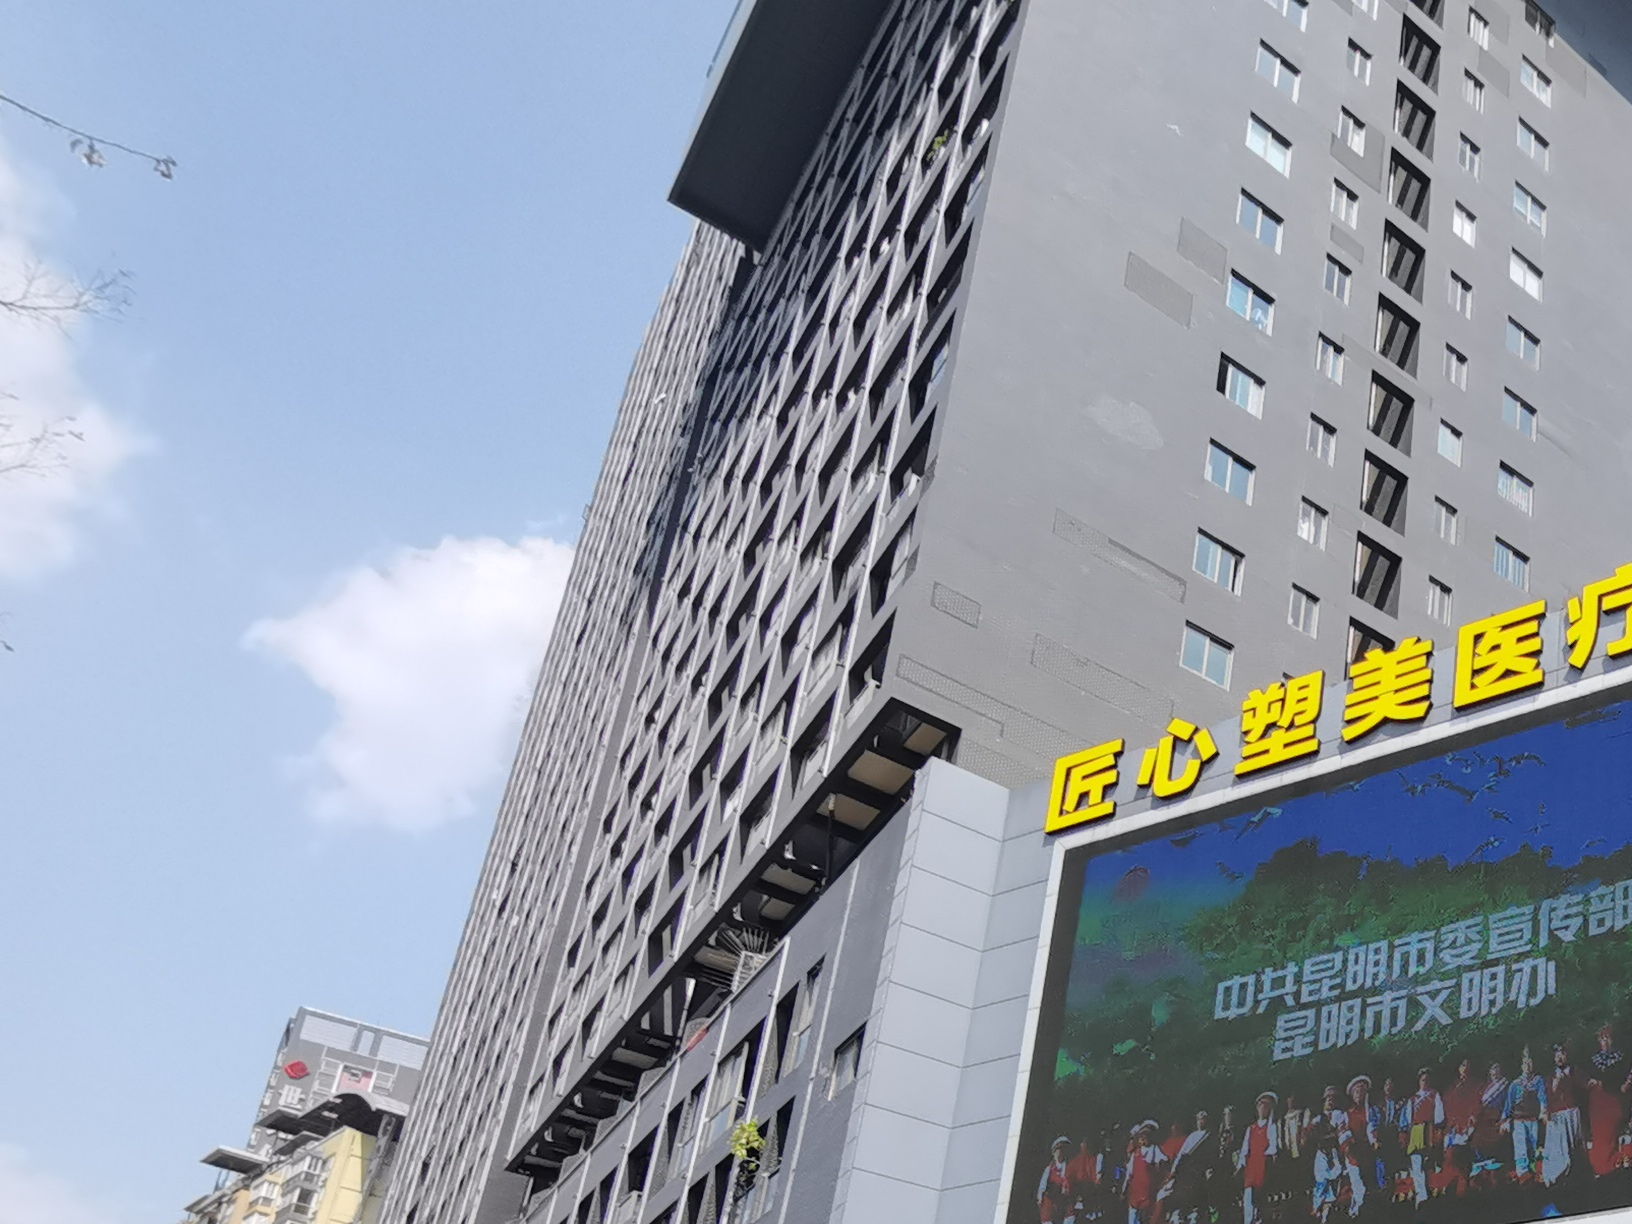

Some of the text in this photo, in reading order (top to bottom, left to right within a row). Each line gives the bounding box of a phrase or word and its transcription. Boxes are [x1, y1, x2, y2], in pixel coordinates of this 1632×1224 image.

[1271, 955, 1558, 1063] 昆明市文明办
